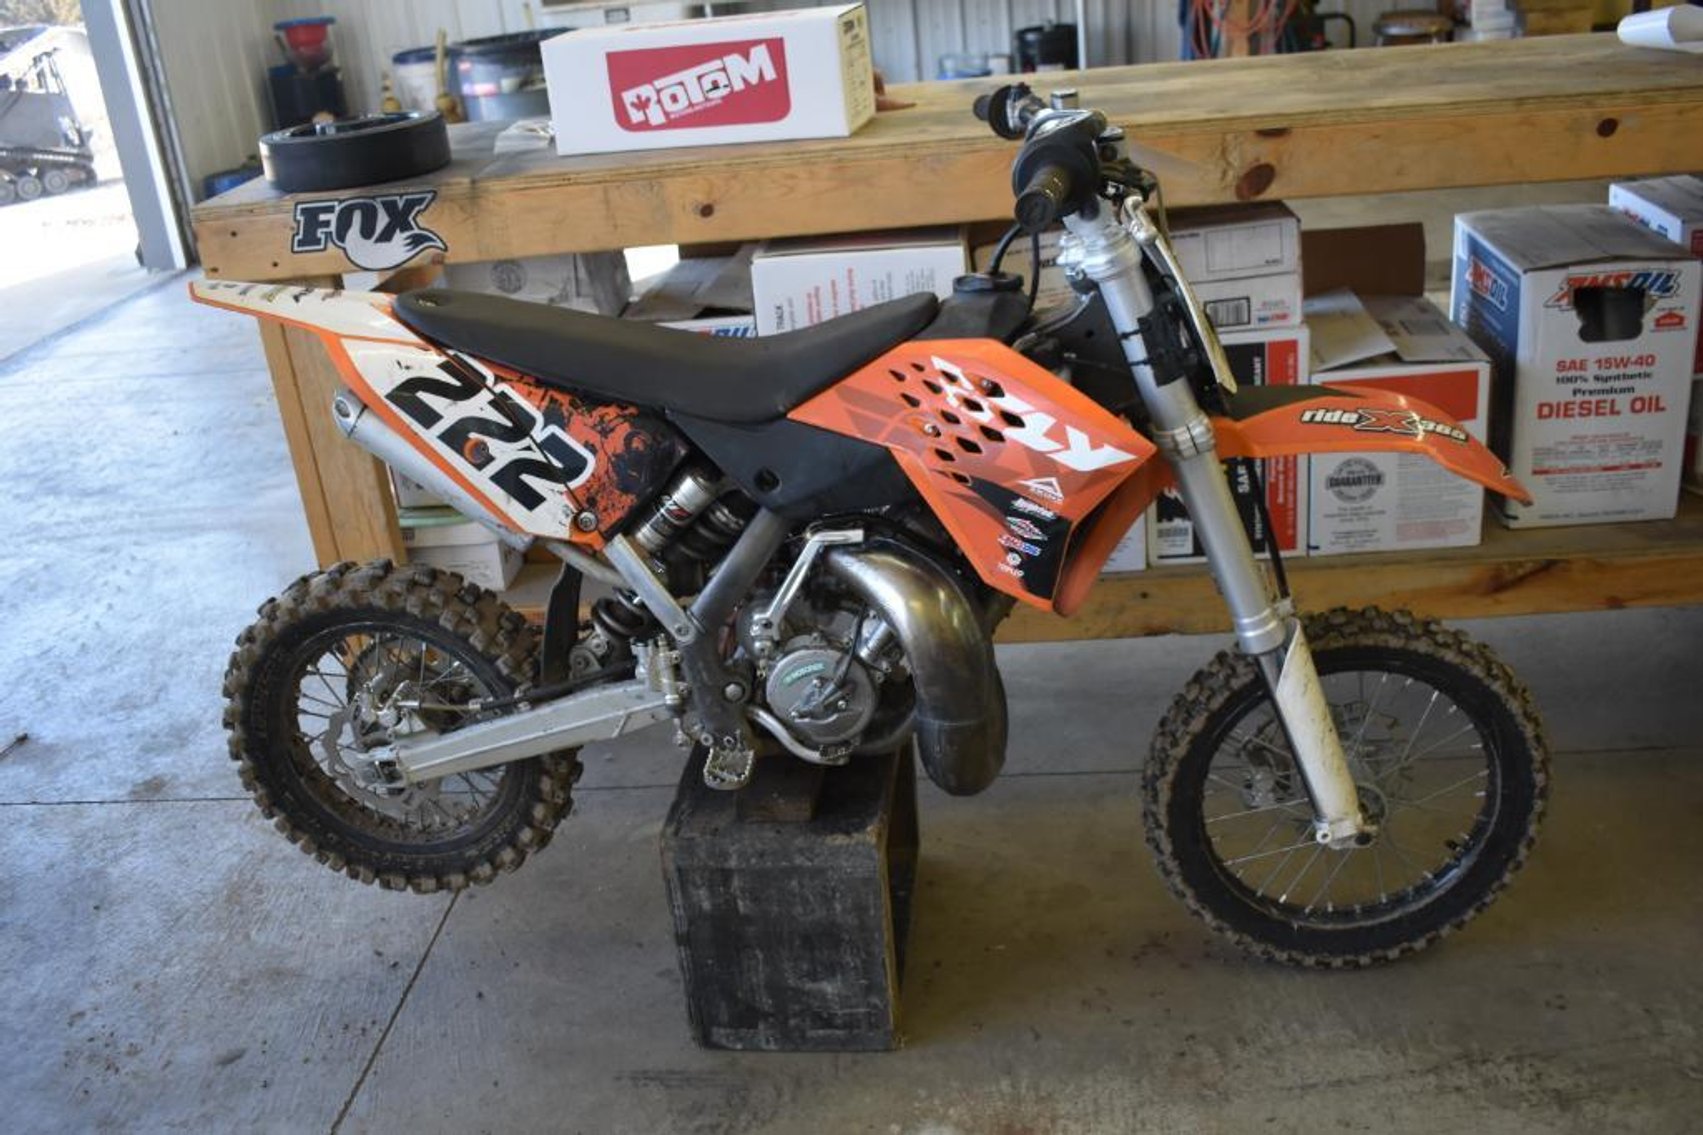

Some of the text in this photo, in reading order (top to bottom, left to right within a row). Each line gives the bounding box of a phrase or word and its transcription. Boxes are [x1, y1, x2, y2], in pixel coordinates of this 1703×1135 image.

[621, 43, 778, 127] ROTOM
[292, 190, 438, 254] FOX
[1556, 353, 1656, 373] SAE 15W-40
[1556, 371, 1654, 385] 100% Synthetic
[1572, 384, 1636, 397] Premium
[1536, 394, 1667, 420] DIESEL OIL
[385, 353, 589, 512] 222
